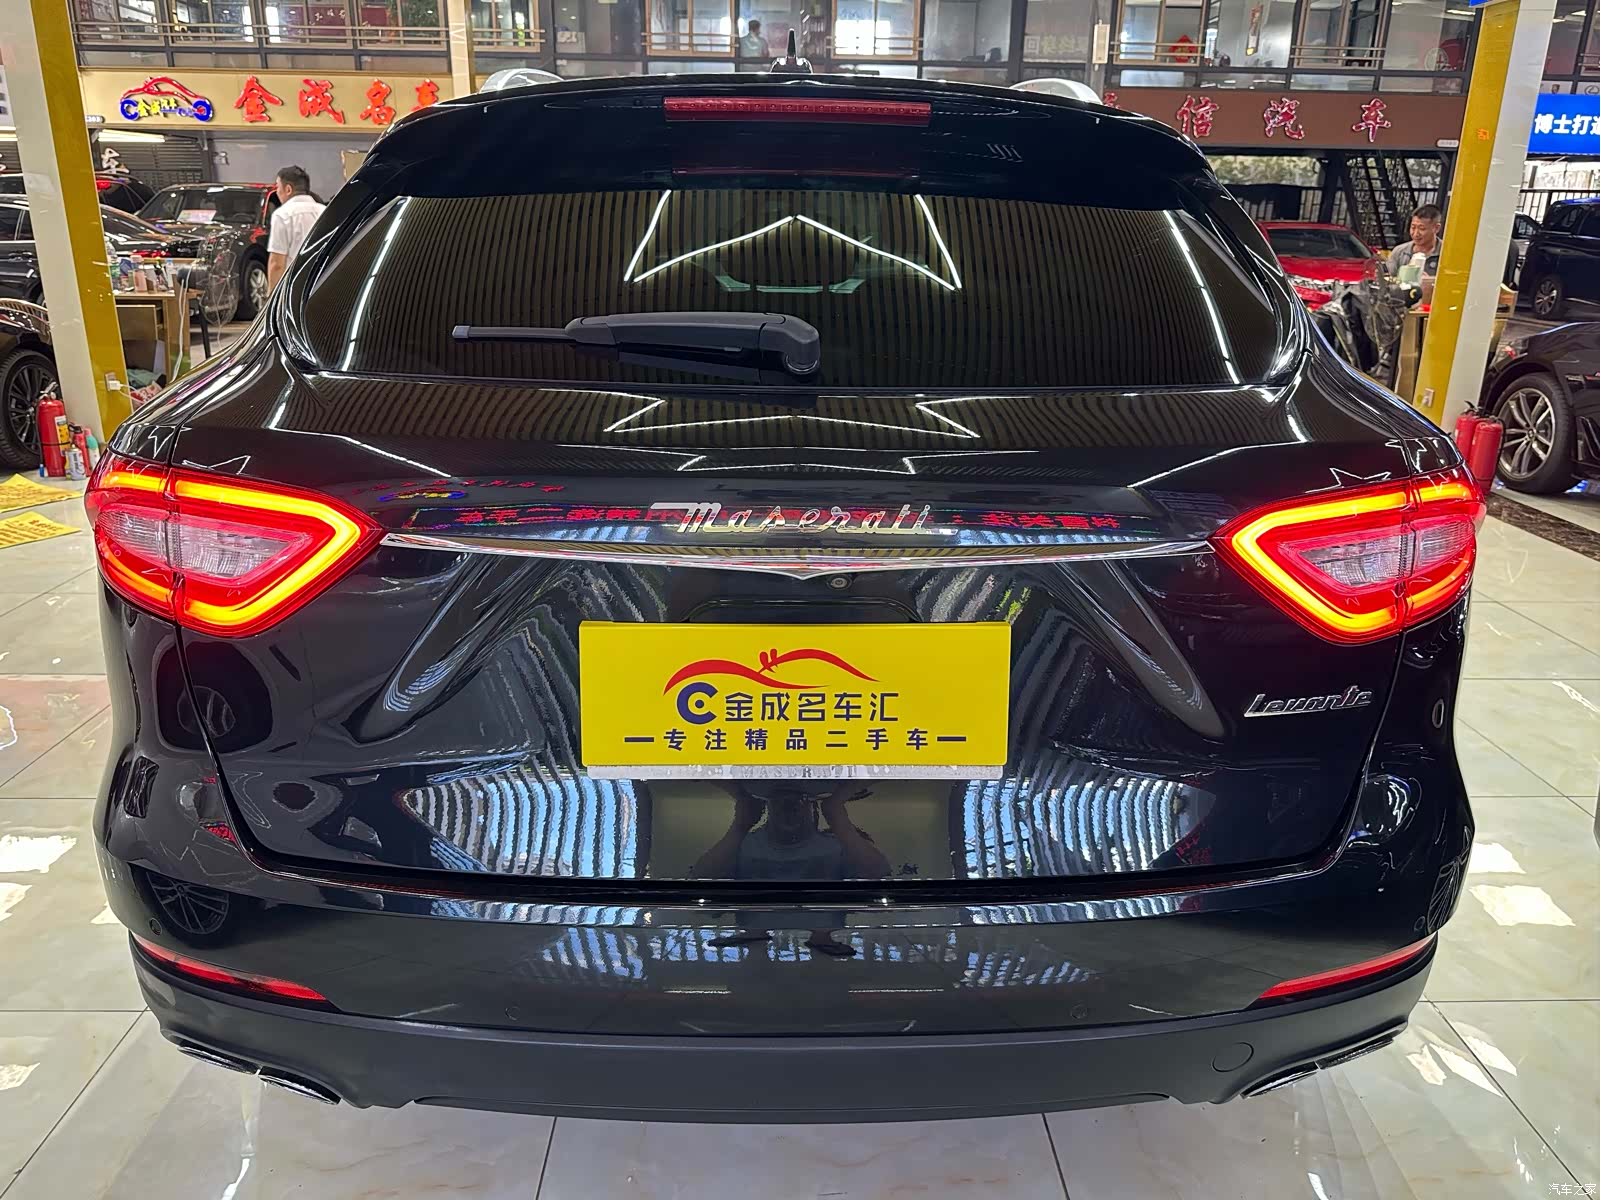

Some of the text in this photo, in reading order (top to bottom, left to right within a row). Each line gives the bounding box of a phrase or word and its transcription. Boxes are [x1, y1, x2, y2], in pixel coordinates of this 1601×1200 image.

[650, 502, 958, 535] Maserati
[724, 692, 899, 722] 金成名车汇
[1244, 685, 1372, 717] Levante
[663, 728, 929, 751] 专注精品二手车
[741, 765, 857, 778] MASERATI
